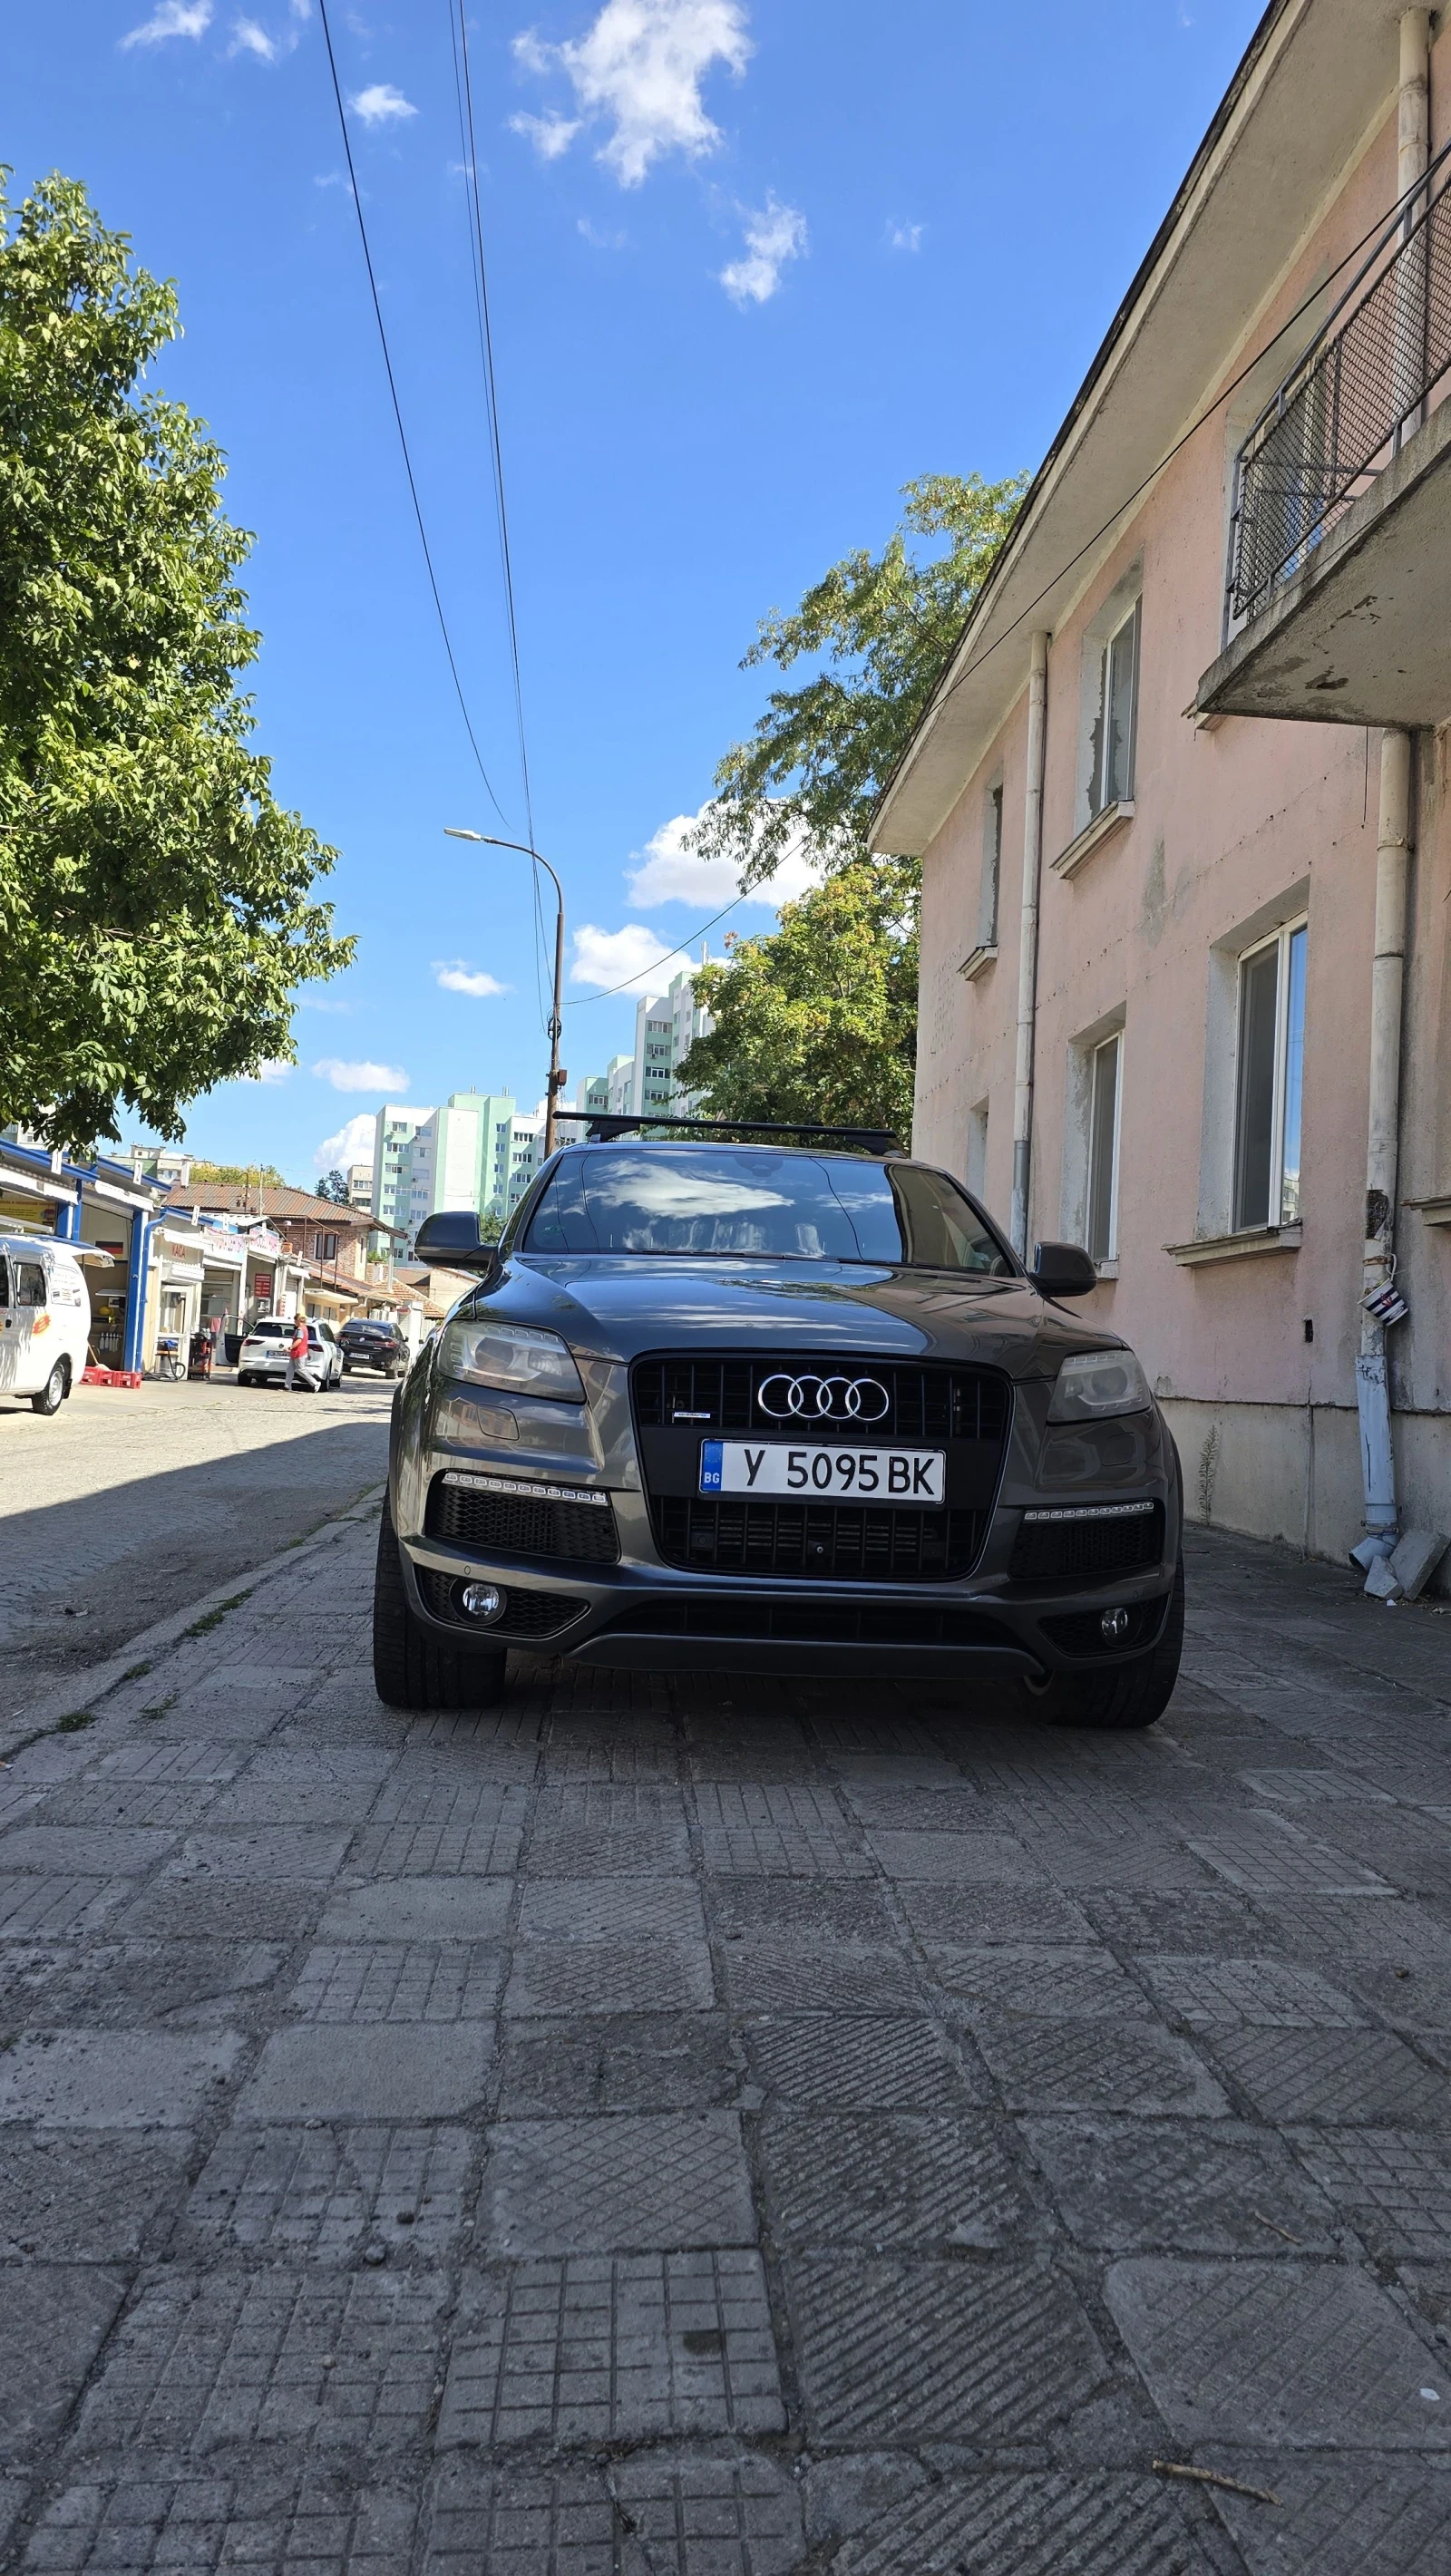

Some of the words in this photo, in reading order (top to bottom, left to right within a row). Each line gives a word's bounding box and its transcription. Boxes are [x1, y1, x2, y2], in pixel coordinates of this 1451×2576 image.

[704, 1472, 720, 1483] BG
[787, 1451, 879, 1492] 5095
[888, 1455, 935, 1495] BK
